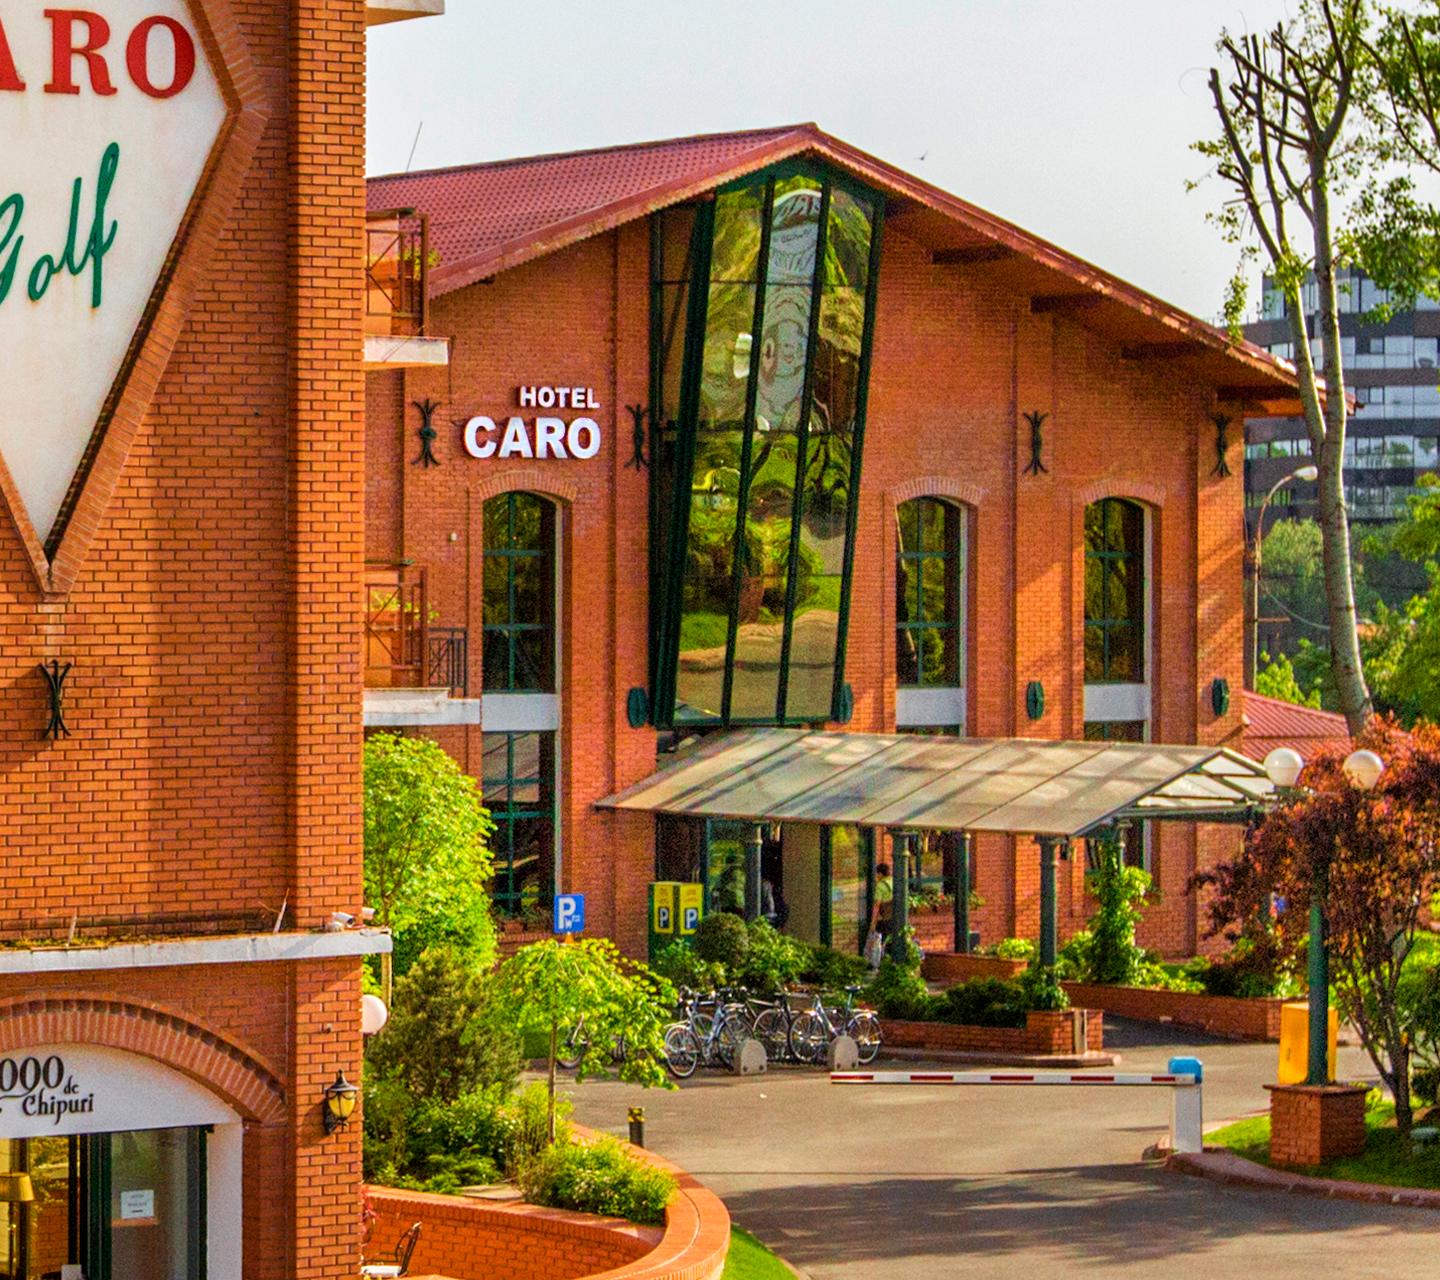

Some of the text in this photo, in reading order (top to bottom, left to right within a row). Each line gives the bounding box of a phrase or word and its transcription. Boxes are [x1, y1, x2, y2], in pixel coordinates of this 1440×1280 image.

[520, 386, 600, 408] HOTEL
[464, 416, 601, 459] CARO
[558, 897, 576, 930] P
[660, 908, 669, 928] P
[686, 909, 697, 929] P
[63, 1075, 80, 1094] de
[22, 1087, 94, 1125] Chipuri
